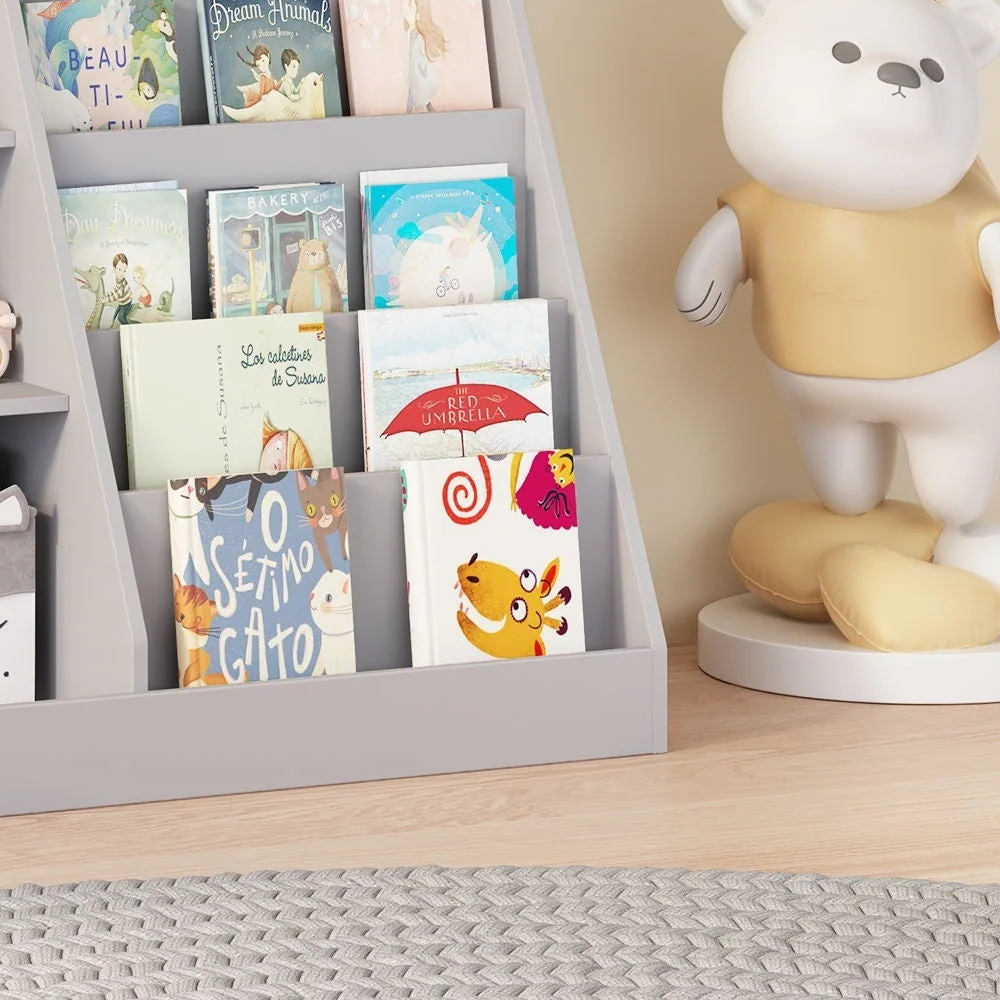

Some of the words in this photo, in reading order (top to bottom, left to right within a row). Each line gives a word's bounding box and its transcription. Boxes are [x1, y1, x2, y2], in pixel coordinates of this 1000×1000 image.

[68, 46, 141, 71] BEAU-
[89, 84, 123, 107] TI-
[247, 191, 309, 209] BAKERY
[241, 344, 265, 368] Los
[268, 344, 312, 363] calcetines
[272, 369, 283, 387] de
[285, 366, 326, 387] Susana
[455, 387, 469, 395] THE
[447, 395, 478, 410] RED
[421, 406, 507, 426] UMBRELLA
[260, 489, 289, 553] O
[218, 606, 314, 685] GATO
